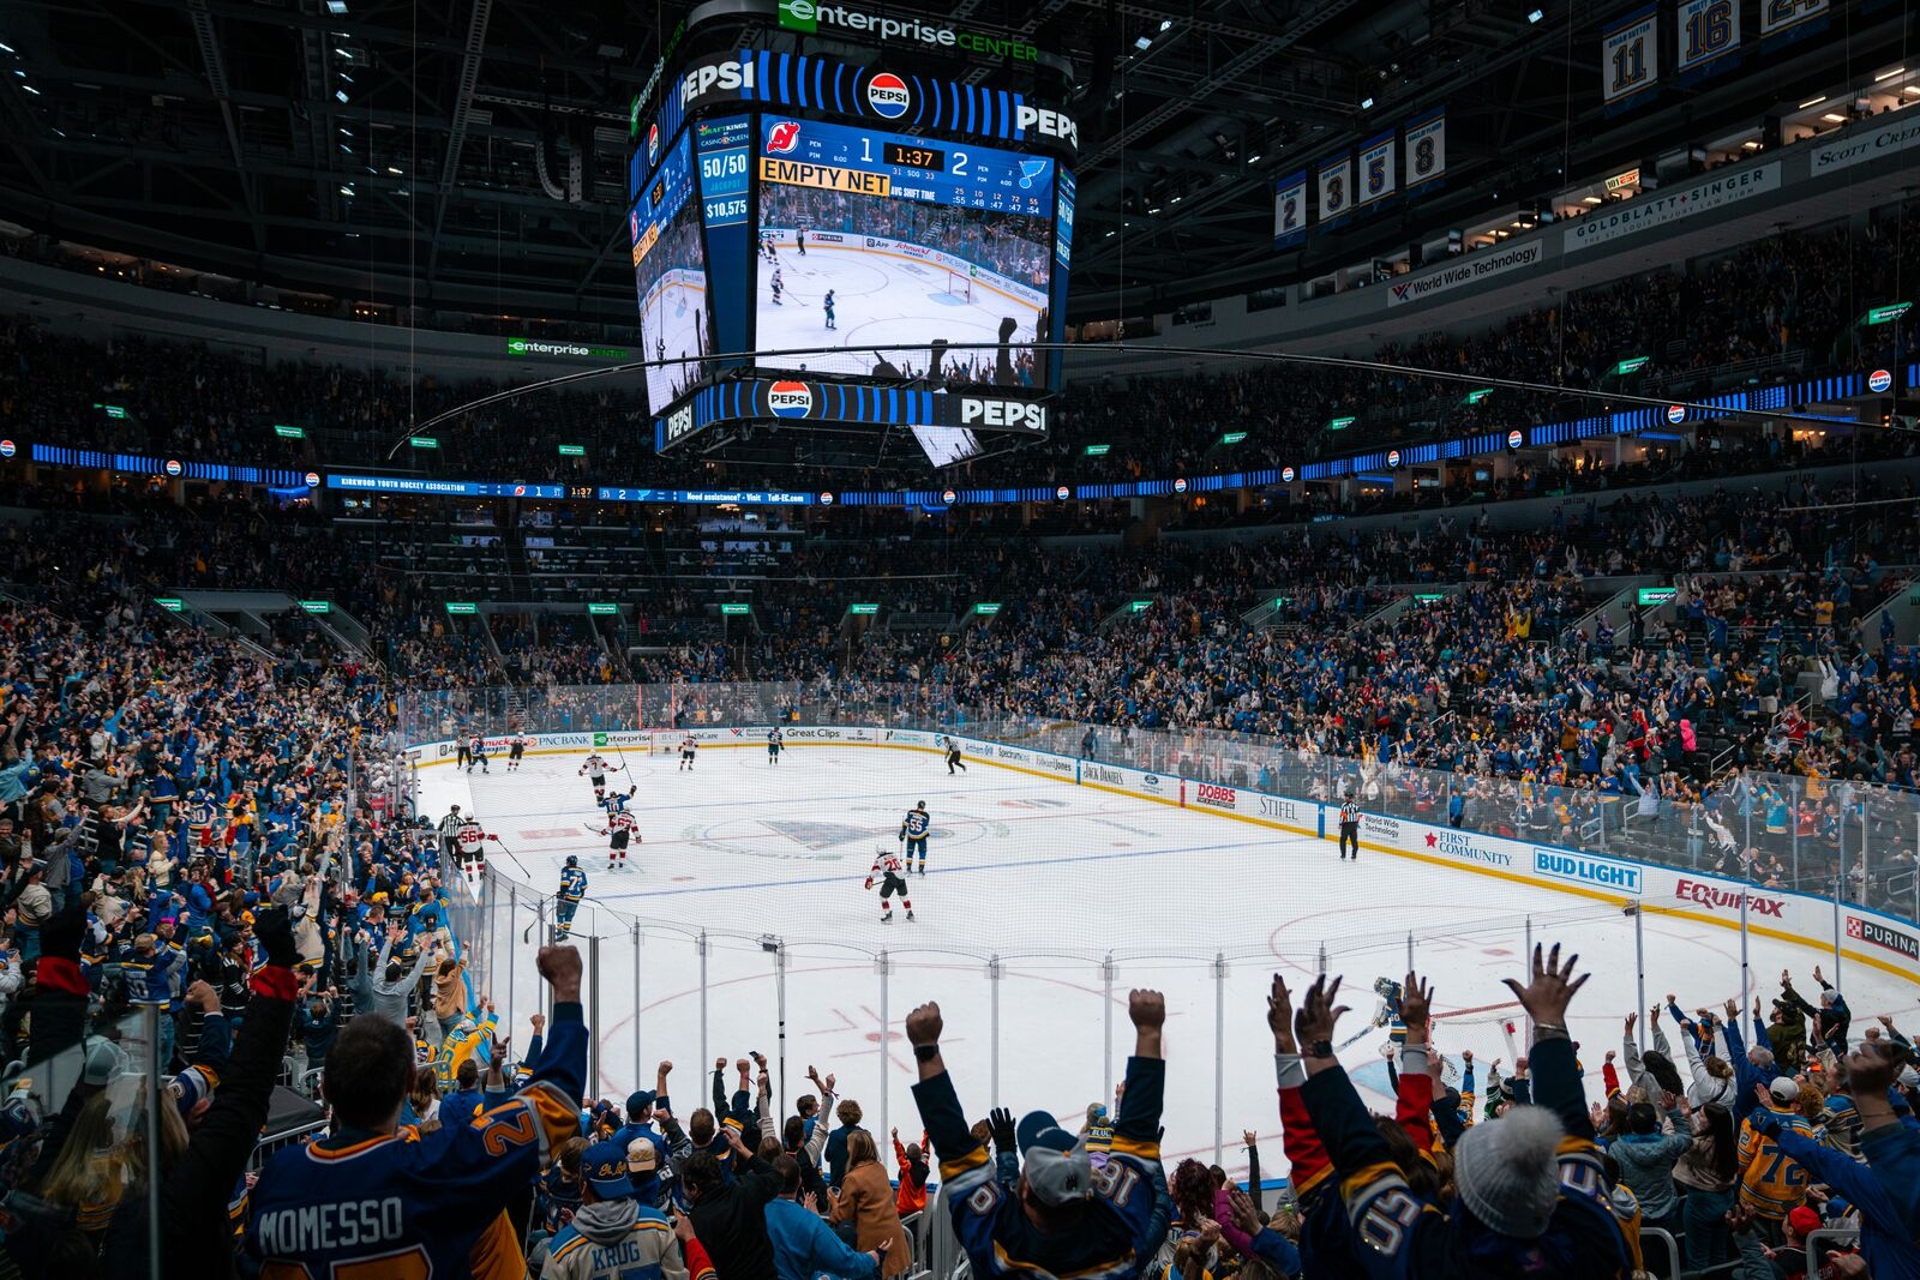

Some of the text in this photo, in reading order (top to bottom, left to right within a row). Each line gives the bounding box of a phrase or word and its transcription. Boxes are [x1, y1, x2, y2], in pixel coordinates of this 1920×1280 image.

[783, 0, 1038, 62] enterprise CENTER
[1686, 1, 1732, 61] 16
[1613, 37, 1647, 92] 11
[681, 61, 754, 111] PEPSI
[869, 86, 909, 105] PEPSI
[1017, 103, 1078, 150] PEPS
[809, 140, 822, 149] PEN
[860, 137, 874, 163] 1
[1415, 136, 1435, 176] 8
[703, 154, 747, 178] 50/50
[896, 148, 933, 167] 1:37
[952, 152, 968, 176] 2
[764, 159, 888, 194] EMPTY NET
[1368, 156, 1386, 195] 5
[890, 186, 936, 201] AVG SHIFT TIME
[1326, 175, 1344, 212] 3
[1577, 168, 1764, 238] GOLDBLATT SINGER
[1700, 198, 1721, 211] LAW
[1726, 187, 1755, 202] FIRM
[706, 199, 747, 219] $10,575
[1283, 198, 1297, 231] 2
[1413, 246, 1538, 295] World Wide Technology
[509, 341, 629, 359] enterprise CENTER
[1870, 377, 1891, 385] PEPSI
[770, 394, 810, 406] PEPSI
[668, 403, 692, 440] PEPSI
[961, 397, 1046, 430] PEPSI
[341, 478, 466, 492] KIRKWOOD YOUTH HOCKEY ASSOCIATION
[535, 486, 542, 497] 1
[571, 487, 592, 495] 1:37
[618, 489, 627, 500] 2
[704, 492, 741, 502] assistance?
[787, 728, 815, 738] Great
[817, 728, 840, 739] Clips
[1083, 763, 1099, 779] JACK
[1198, 783, 1235, 803] DOBBS
[1260, 795, 1298, 821] STIFEL
[909, 818, 923, 833] 55
[1365, 815, 1399, 829] World Wide
[1365, 822, 1399, 838] Technology
[460, 830, 476, 844] 56
[1439, 831, 1471, 846] FIRST
[1439, 842, 1512, 867] COMMUNITY
[1537, 853, 1638, 888] BUD LIGHT
[1676, 878, 1786, 919] EQUIFAX
[1864, 923, 1917, 955] PURINA
[1761, 1143, 1806, 1187] 72
[259, 1196, 403, 1255] MOMESSO
[591, 1240, 641, 1272] KRUG
